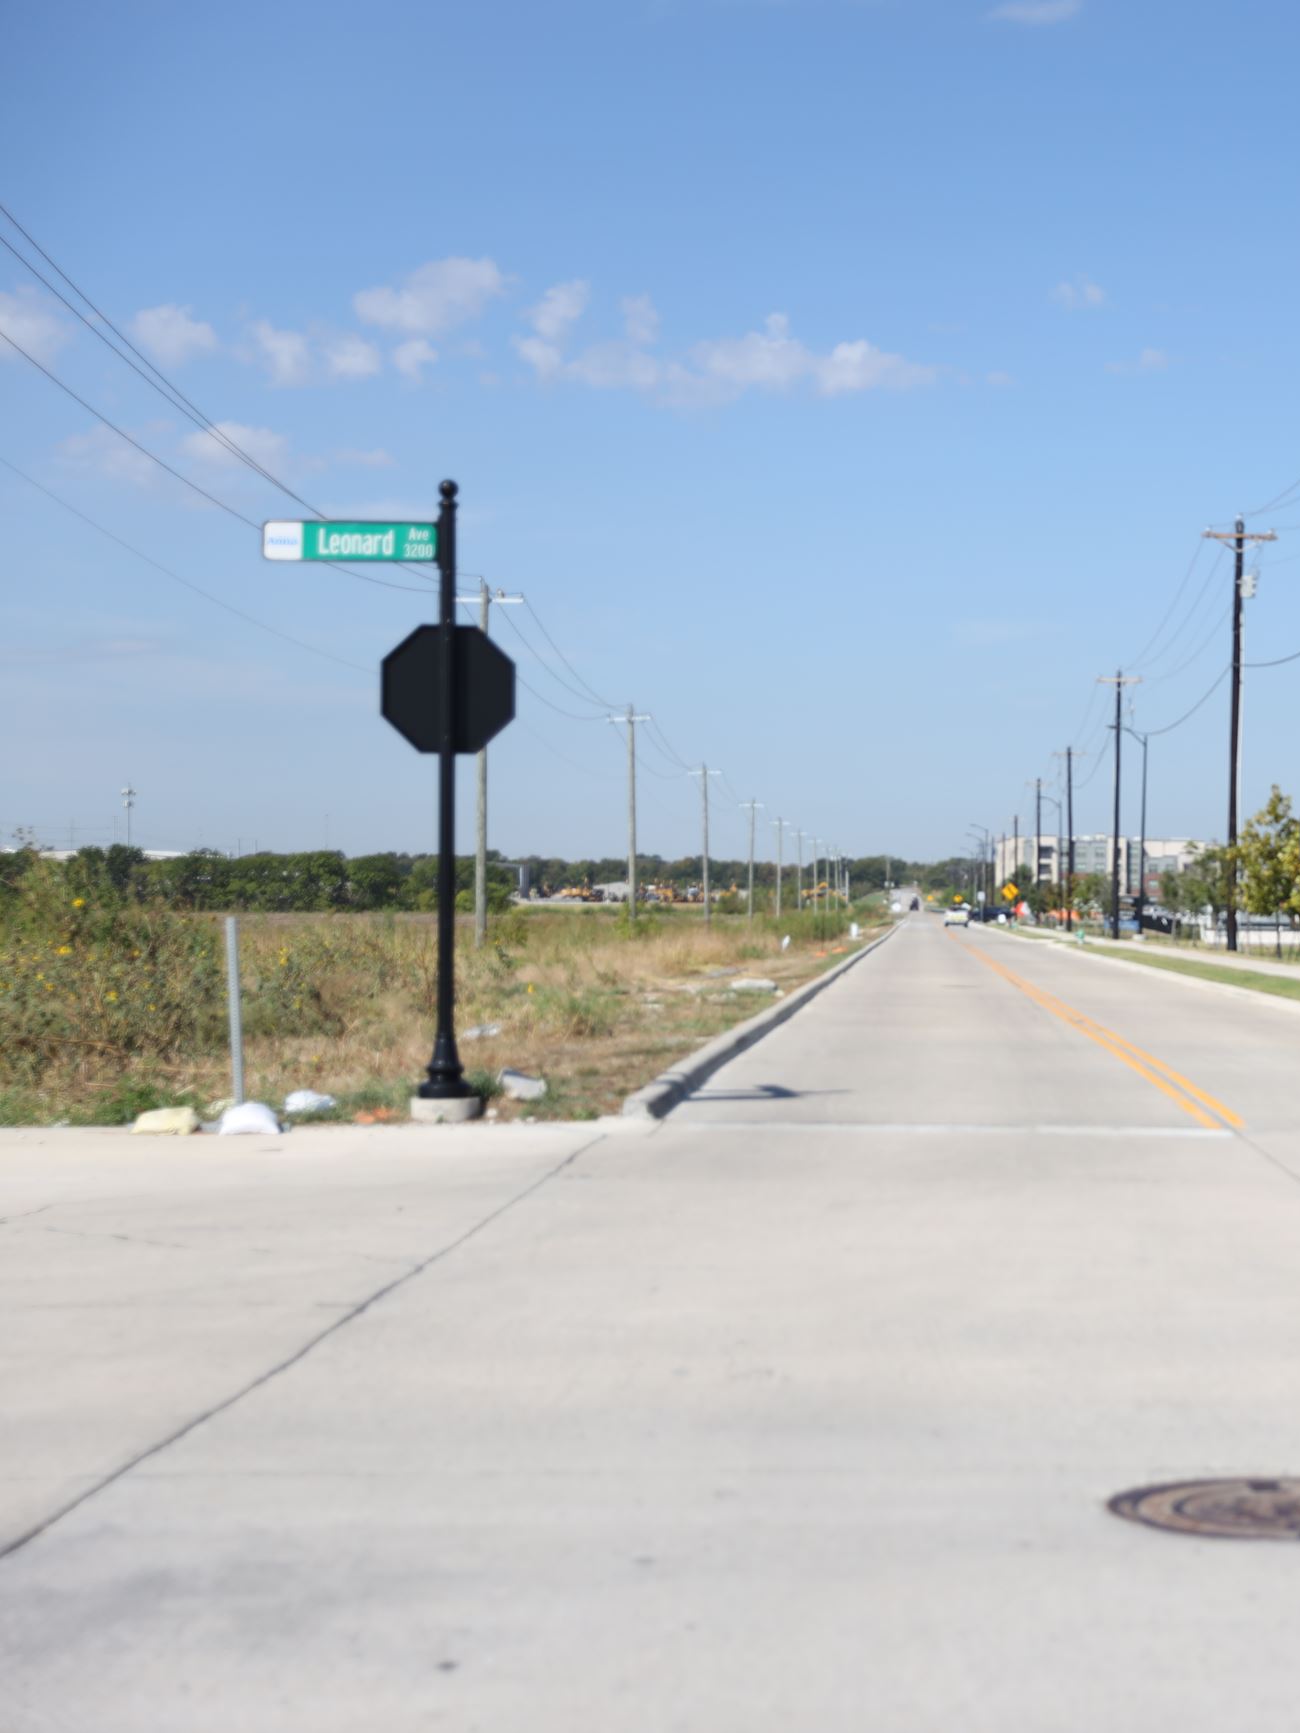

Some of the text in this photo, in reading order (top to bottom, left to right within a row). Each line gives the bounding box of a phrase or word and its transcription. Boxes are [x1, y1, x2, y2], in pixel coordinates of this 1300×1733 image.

[318, 527, 395, 555] Leonard
[408, 527, 430, 541] Ave
[403, 543, 433, 558] 3200
